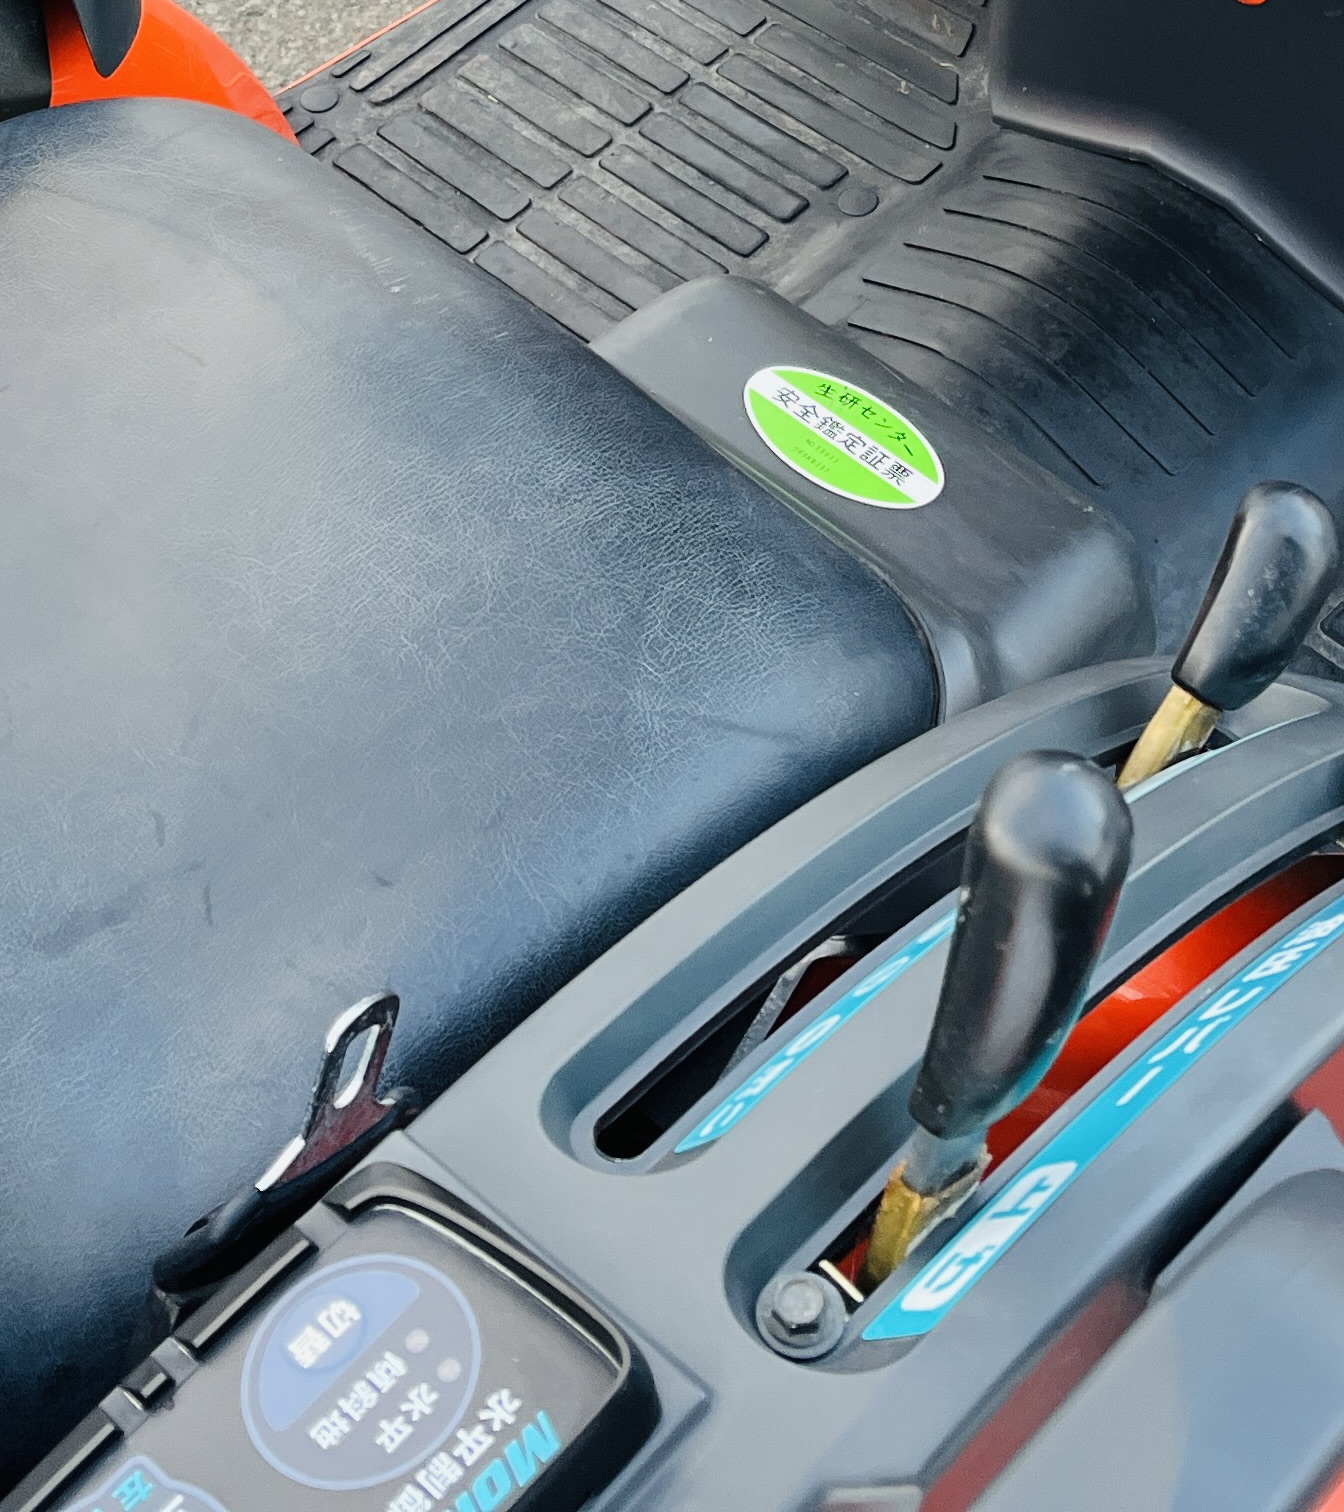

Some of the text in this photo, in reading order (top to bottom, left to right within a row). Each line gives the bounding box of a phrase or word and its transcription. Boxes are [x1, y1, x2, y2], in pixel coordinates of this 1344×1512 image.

[772, 386, 914, 487] 安全鑑定証票
[814, 382, 914, 457] 生研センター
[308, 1350, 406, 1450] 傾斜地
[375, 1381, 441, 1455] 水平
